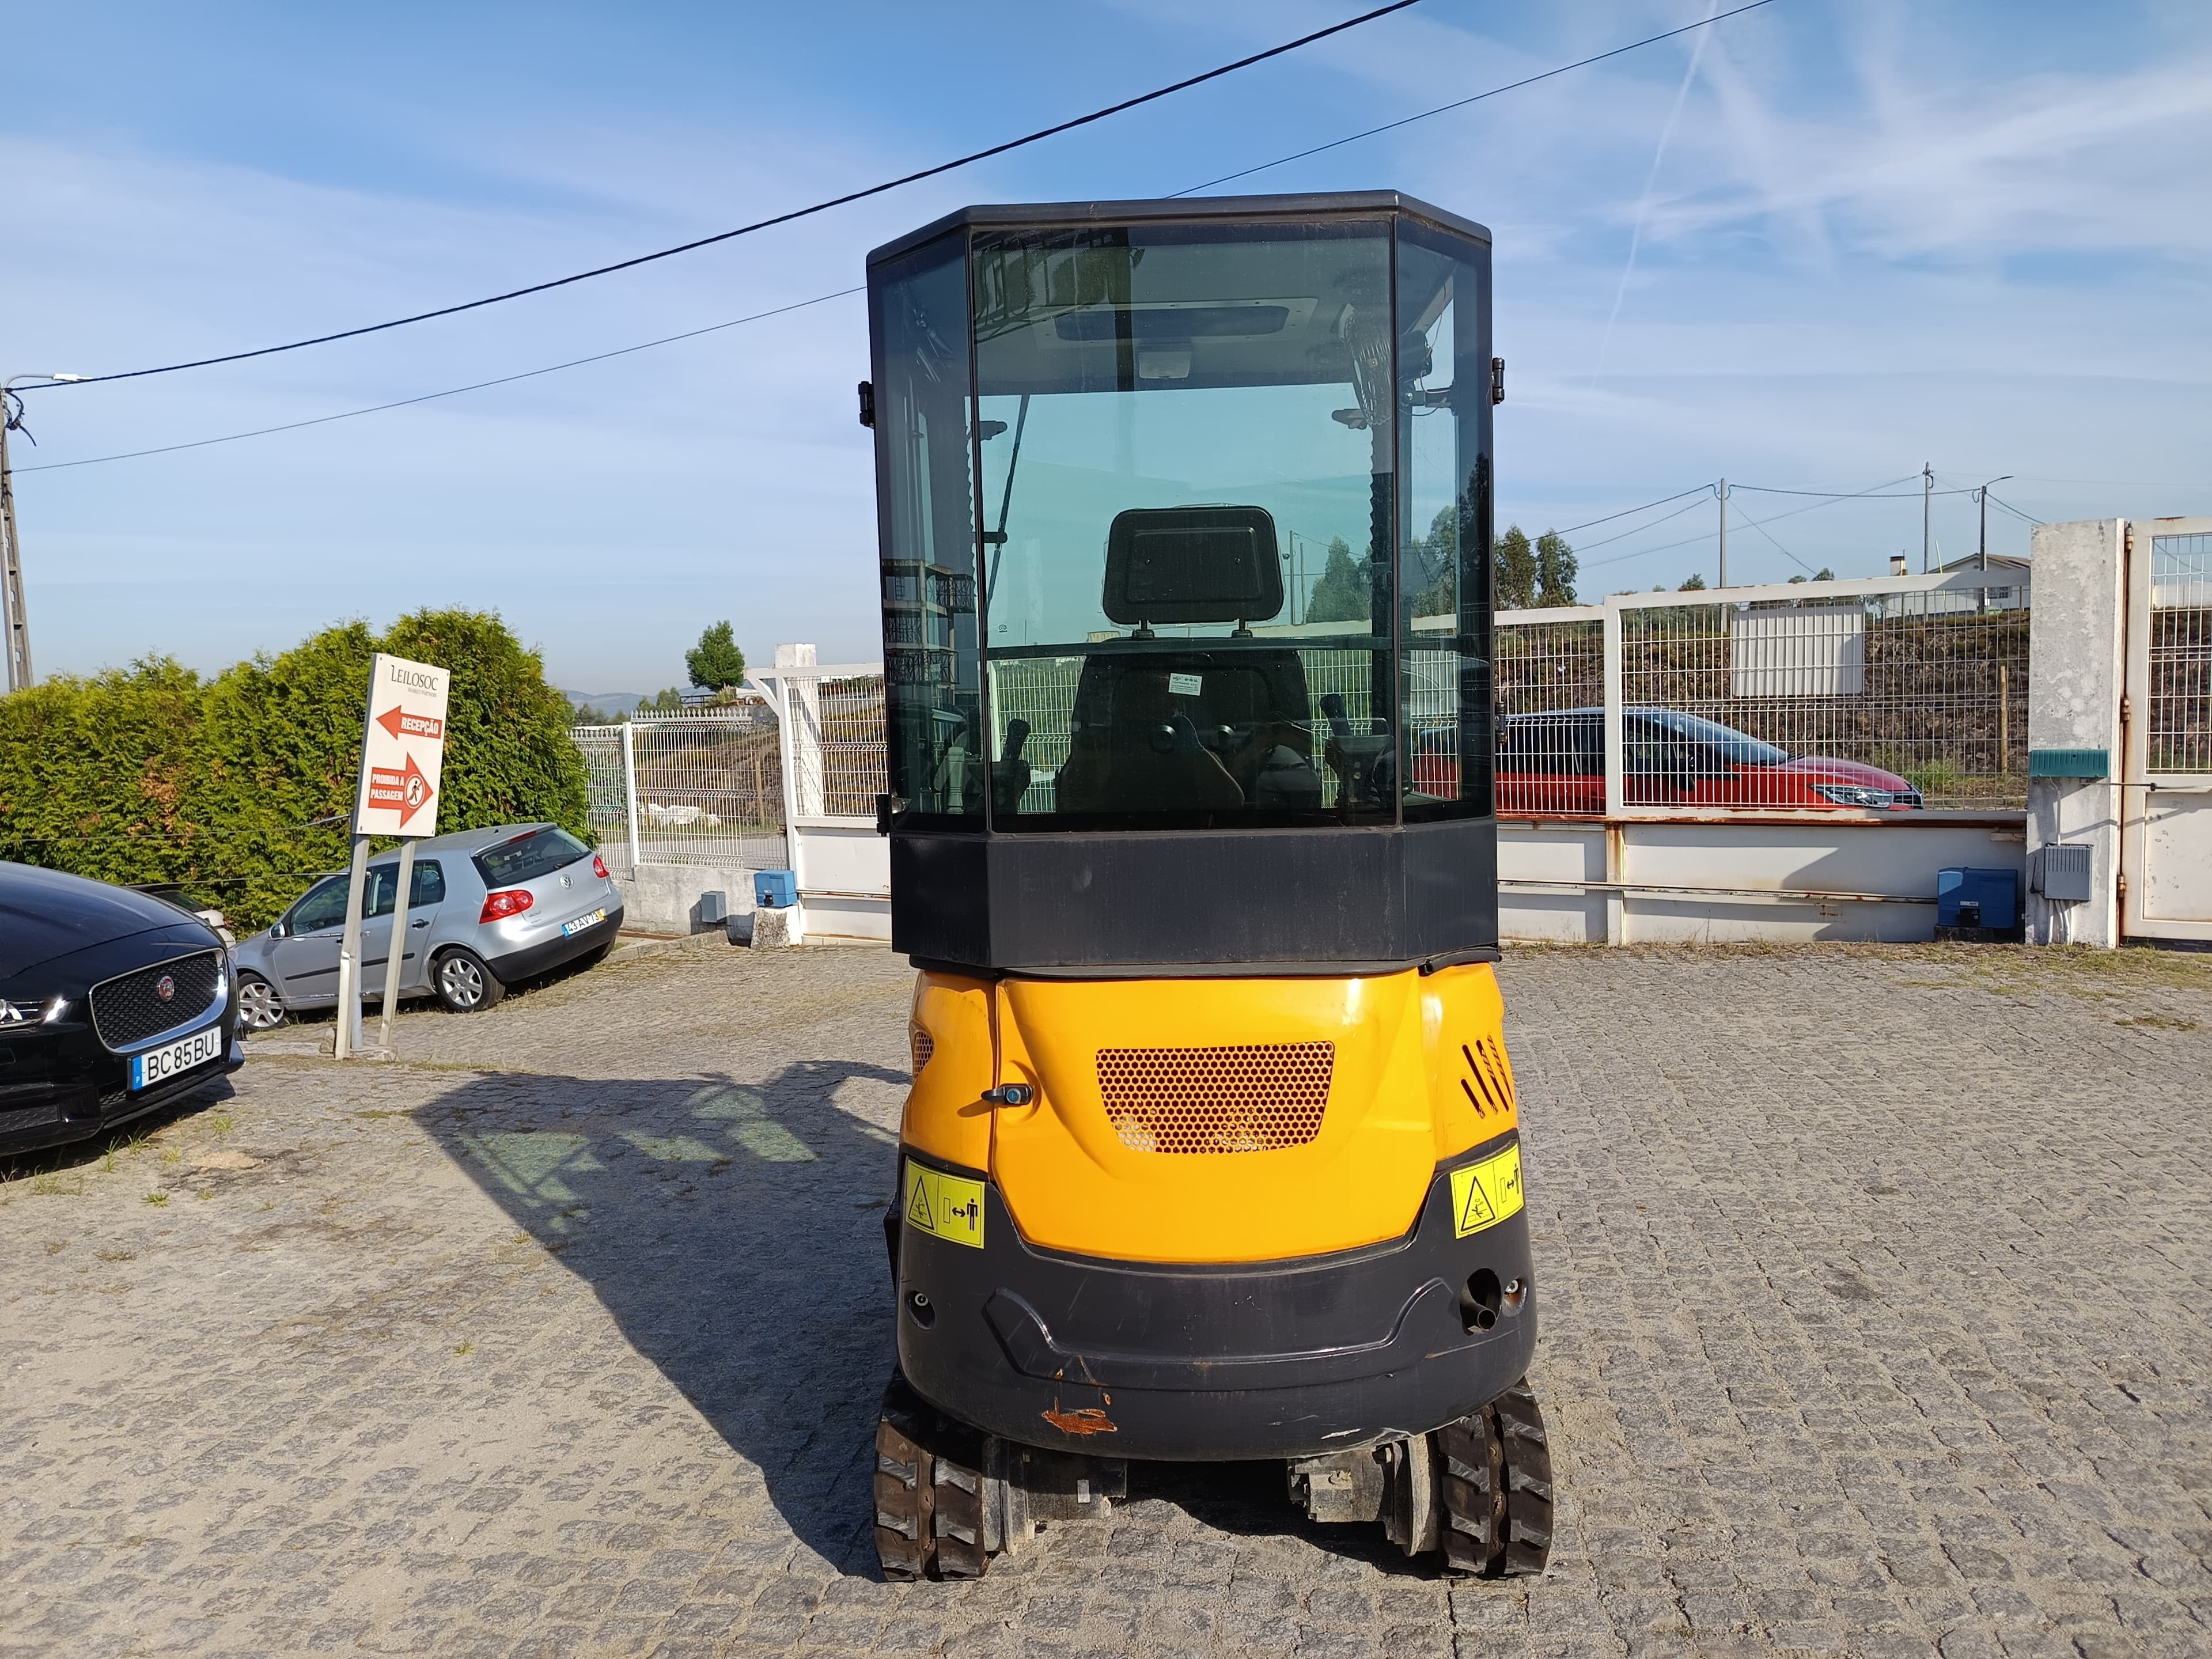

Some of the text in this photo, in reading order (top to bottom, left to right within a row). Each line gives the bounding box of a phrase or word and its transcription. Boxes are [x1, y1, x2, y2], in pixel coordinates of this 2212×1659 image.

[391, 664, 438, 691] LEILOSOC
[401, 716, 439, 737] RECEPÇÃO
[399, 775, 405, 786] A
[370, 788, 404, 801] PASSAGEM
